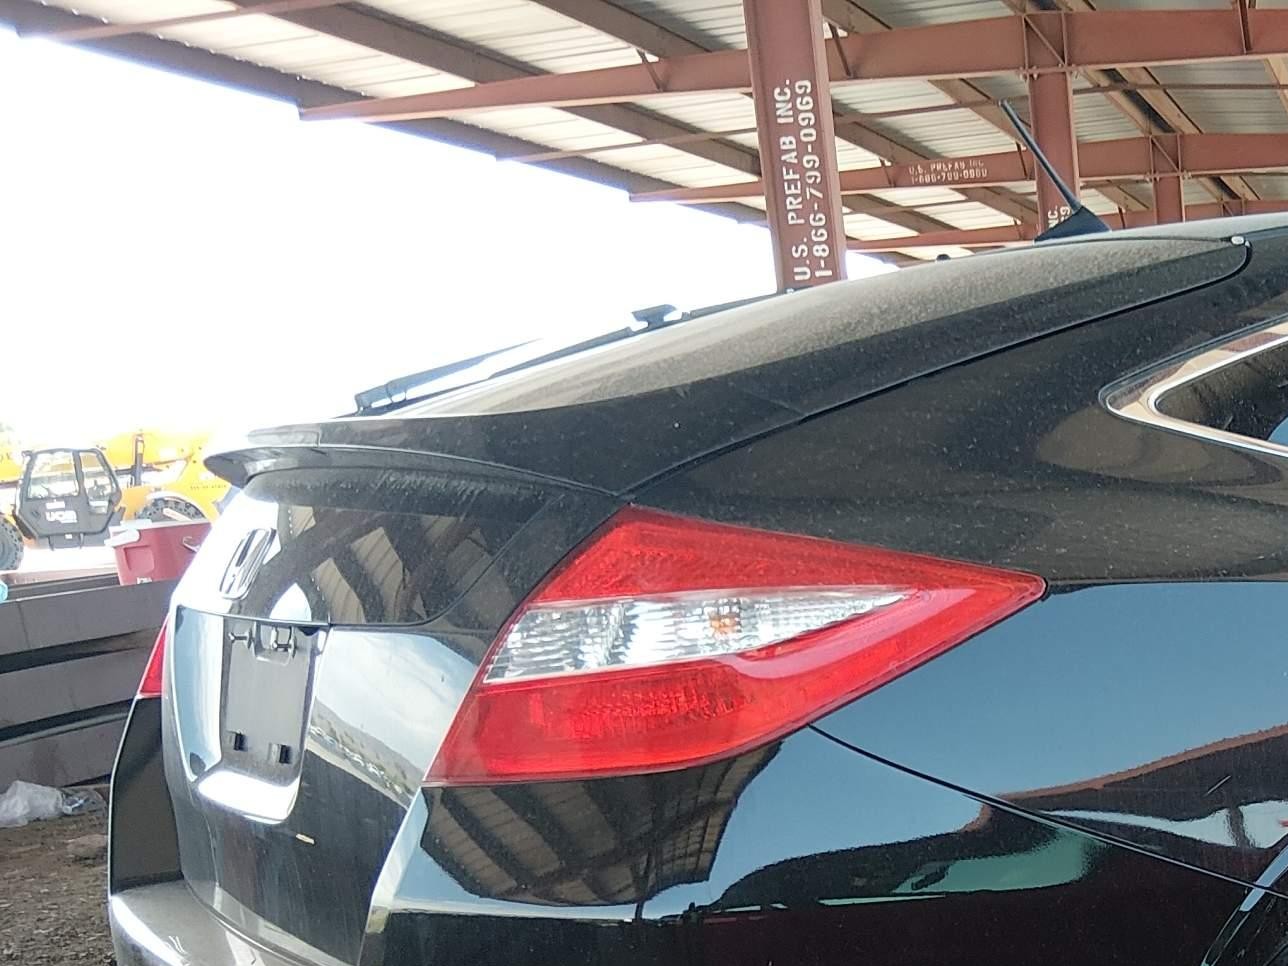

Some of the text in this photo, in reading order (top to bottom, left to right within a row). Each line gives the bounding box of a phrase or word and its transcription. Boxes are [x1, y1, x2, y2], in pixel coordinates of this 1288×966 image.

[774, 79, 811, 281] U.S. PREFAB INC.
[795, 79, 833, 278] 1-866-799-0969
